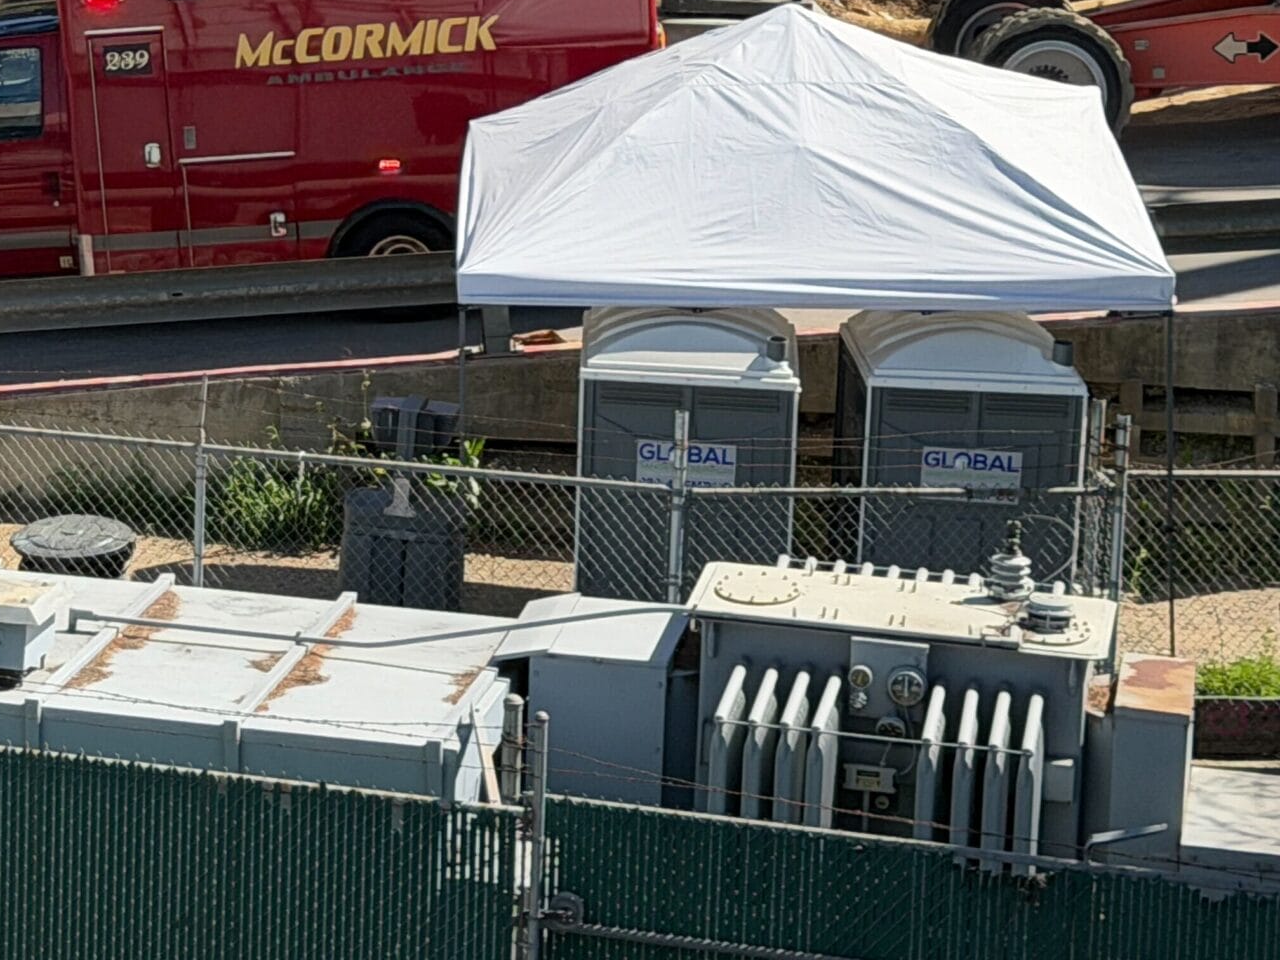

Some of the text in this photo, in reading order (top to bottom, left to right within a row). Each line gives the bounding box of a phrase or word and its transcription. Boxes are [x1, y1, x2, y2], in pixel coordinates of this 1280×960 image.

[105, 49, 150, 71] 239
[266, 61, 466, 86] AMBULANCE
[639, 443, 735, 465] GLBAL
[924, 450, 1020, 473] GLOBAL
